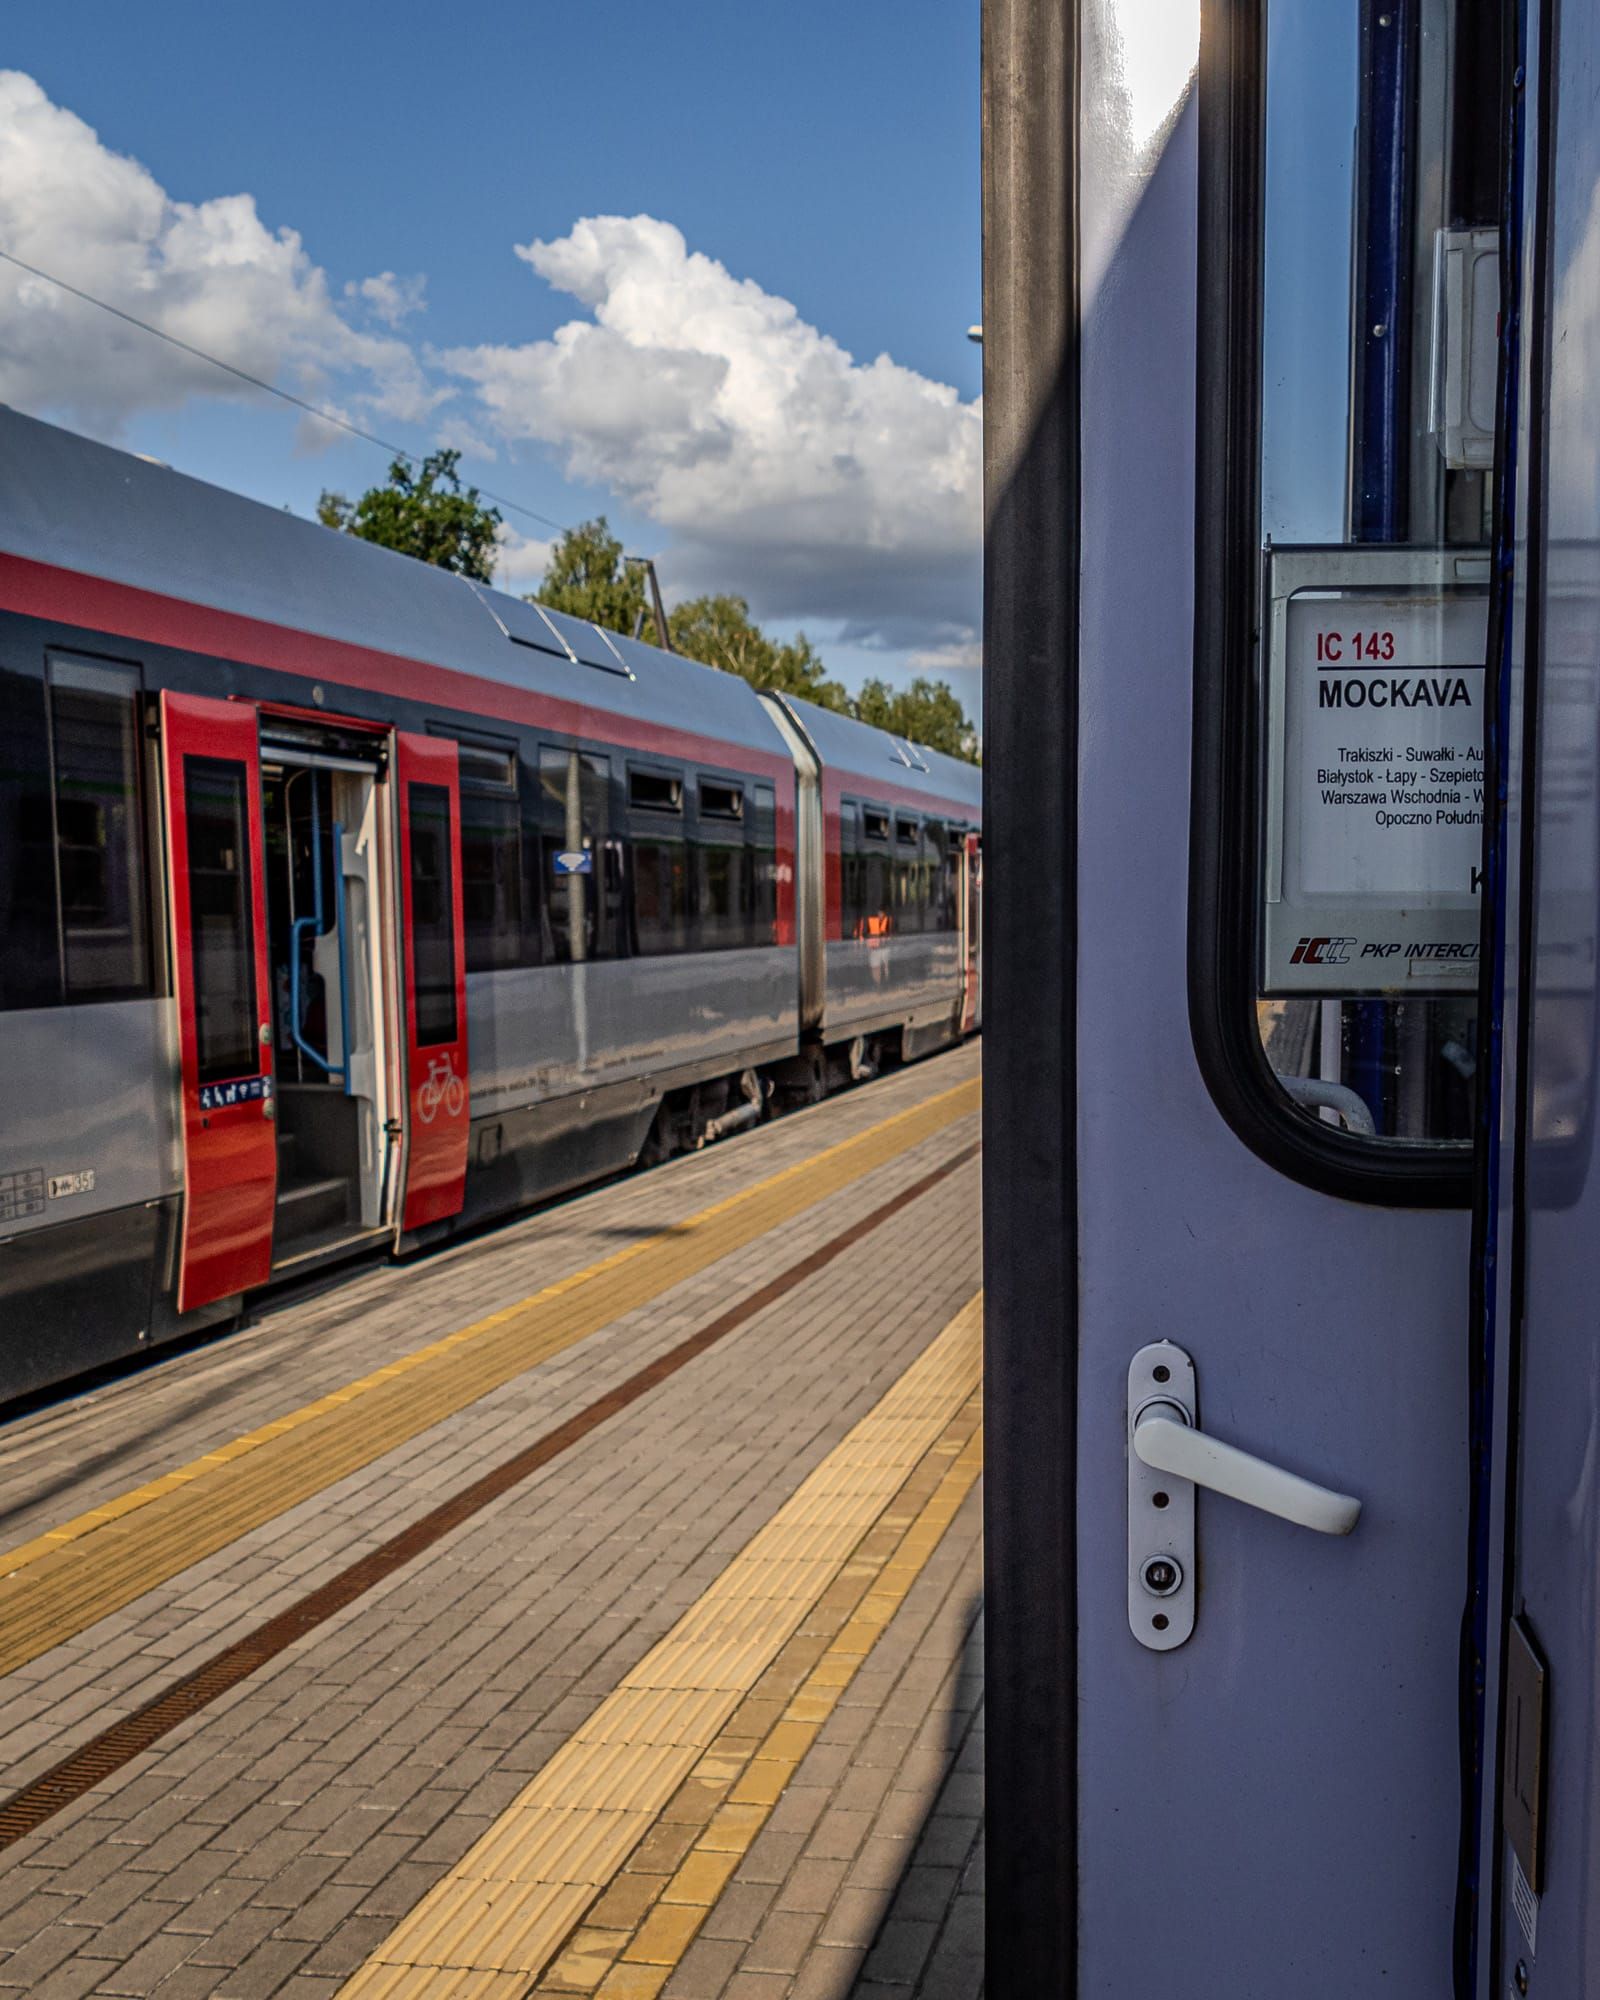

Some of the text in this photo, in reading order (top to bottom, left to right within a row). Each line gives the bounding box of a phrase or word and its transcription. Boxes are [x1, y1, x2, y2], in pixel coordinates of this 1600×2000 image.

[1317, 632, 1395, 661] IC 143
[1319, 679, 1471, 707] MOCKAVA
[1337, 747, 1393, 762] Trakiszki
[1405, 746, 1455, 762] Suwałki
[1317, 768, 1374, 787] Białystok
[1321, 789, 1387, 805] Warszawa
[1390, 788, 1461, 804] Wschodnia
[1375, 809, 1432, 828] Opoczno
[1360, 943, 1401, 958] PKP
[1404, 943, 1481, 958] INTERCI
